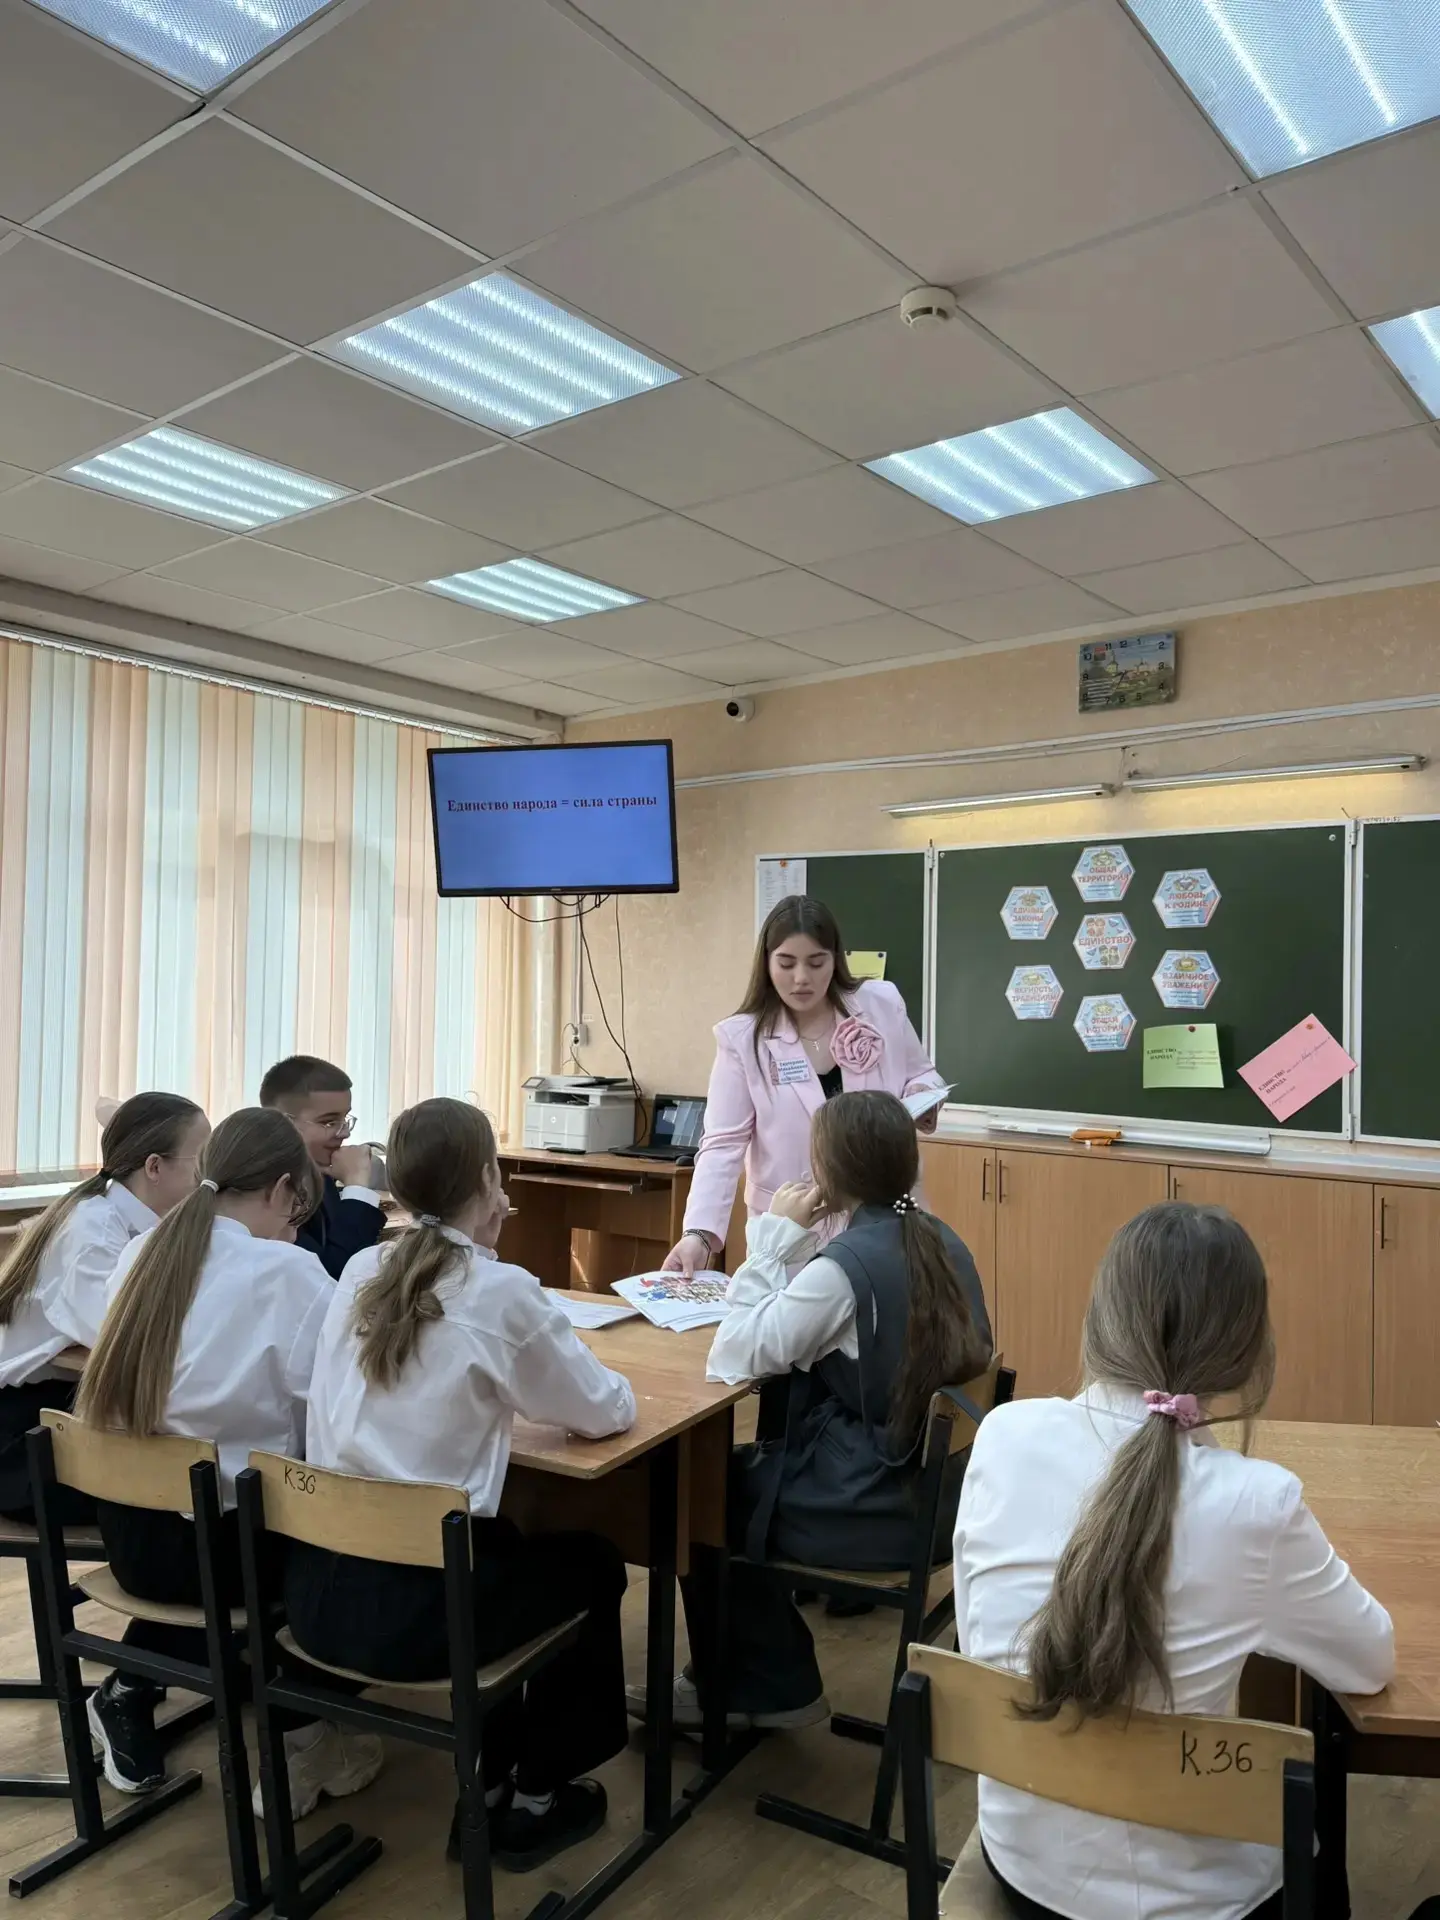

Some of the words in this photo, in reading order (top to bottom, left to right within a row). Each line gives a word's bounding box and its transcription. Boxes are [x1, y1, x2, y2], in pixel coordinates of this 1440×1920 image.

[1158, 641, 1165, 650] 2
[1158, 662, 1165, 670] 3
[1158, 682, 1164, 690] 4
[447, 800, 509, 812] Единство
[513, 799, 557, 812] народа
[573, 798, 604, 808] сила
[607, 796, 657, 809] страны
[1078, 874, 1129, 883] ТЕРРИТОРИЯ
[1168, 891, 1206, 900] ЛЮБОВЬ
[1173, 901, 1208, 909] РОДИНЕ
[1079, 936, 1130, 946] ЕДИНСТВО
